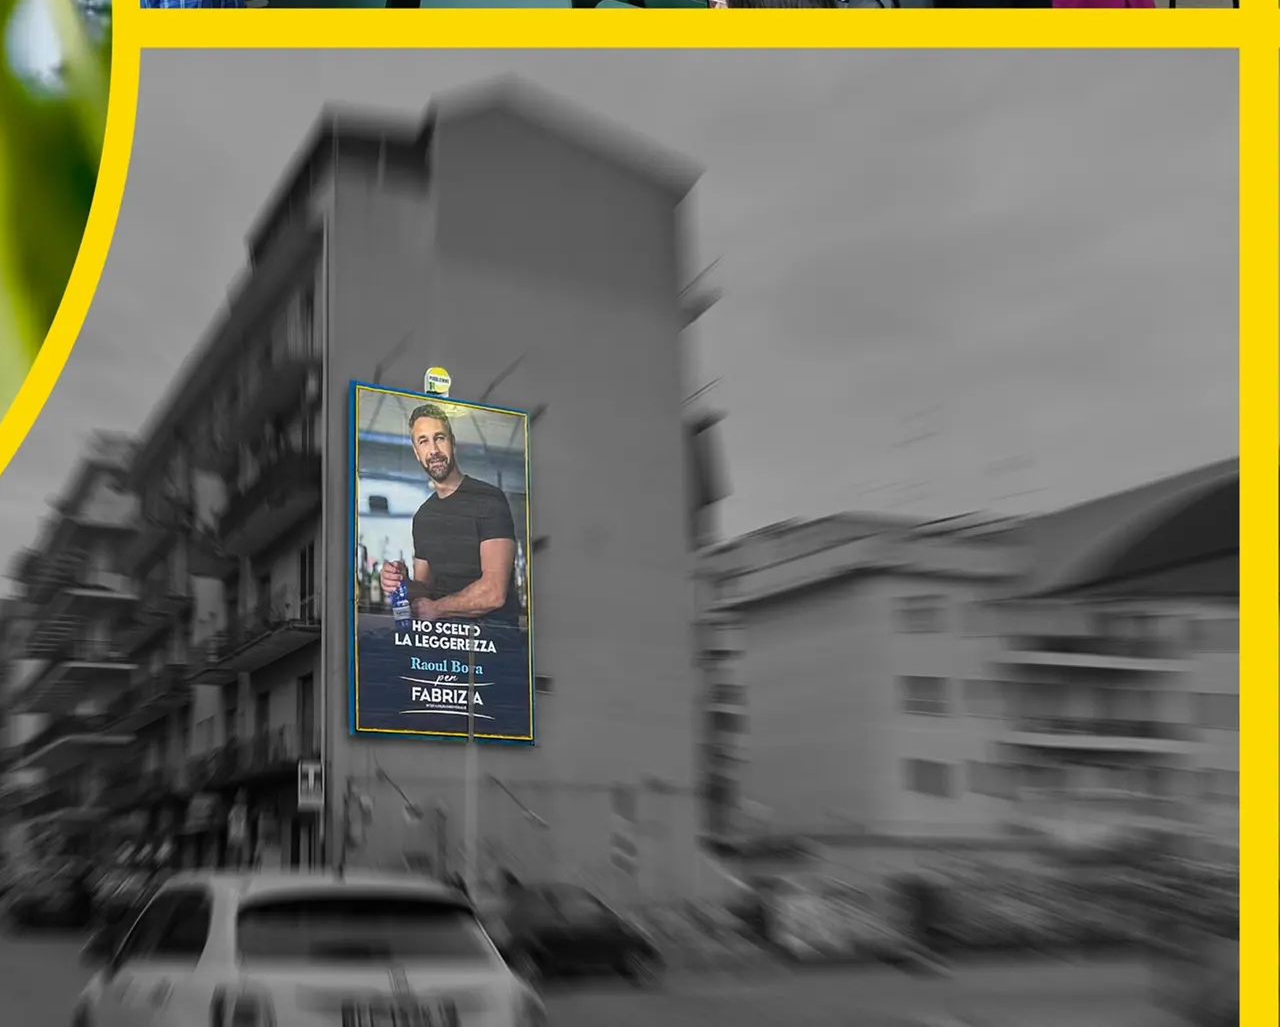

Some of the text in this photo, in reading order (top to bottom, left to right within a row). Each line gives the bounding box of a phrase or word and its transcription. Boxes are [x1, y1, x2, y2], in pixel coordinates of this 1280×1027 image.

[412, 620, 432, 633] HO
[395, 633, 412, 646] LA
[411, 657, 448, 672] Raoul
[434, 675, 459, 686] per
[411, 687, 484, 705] FABRIZA
